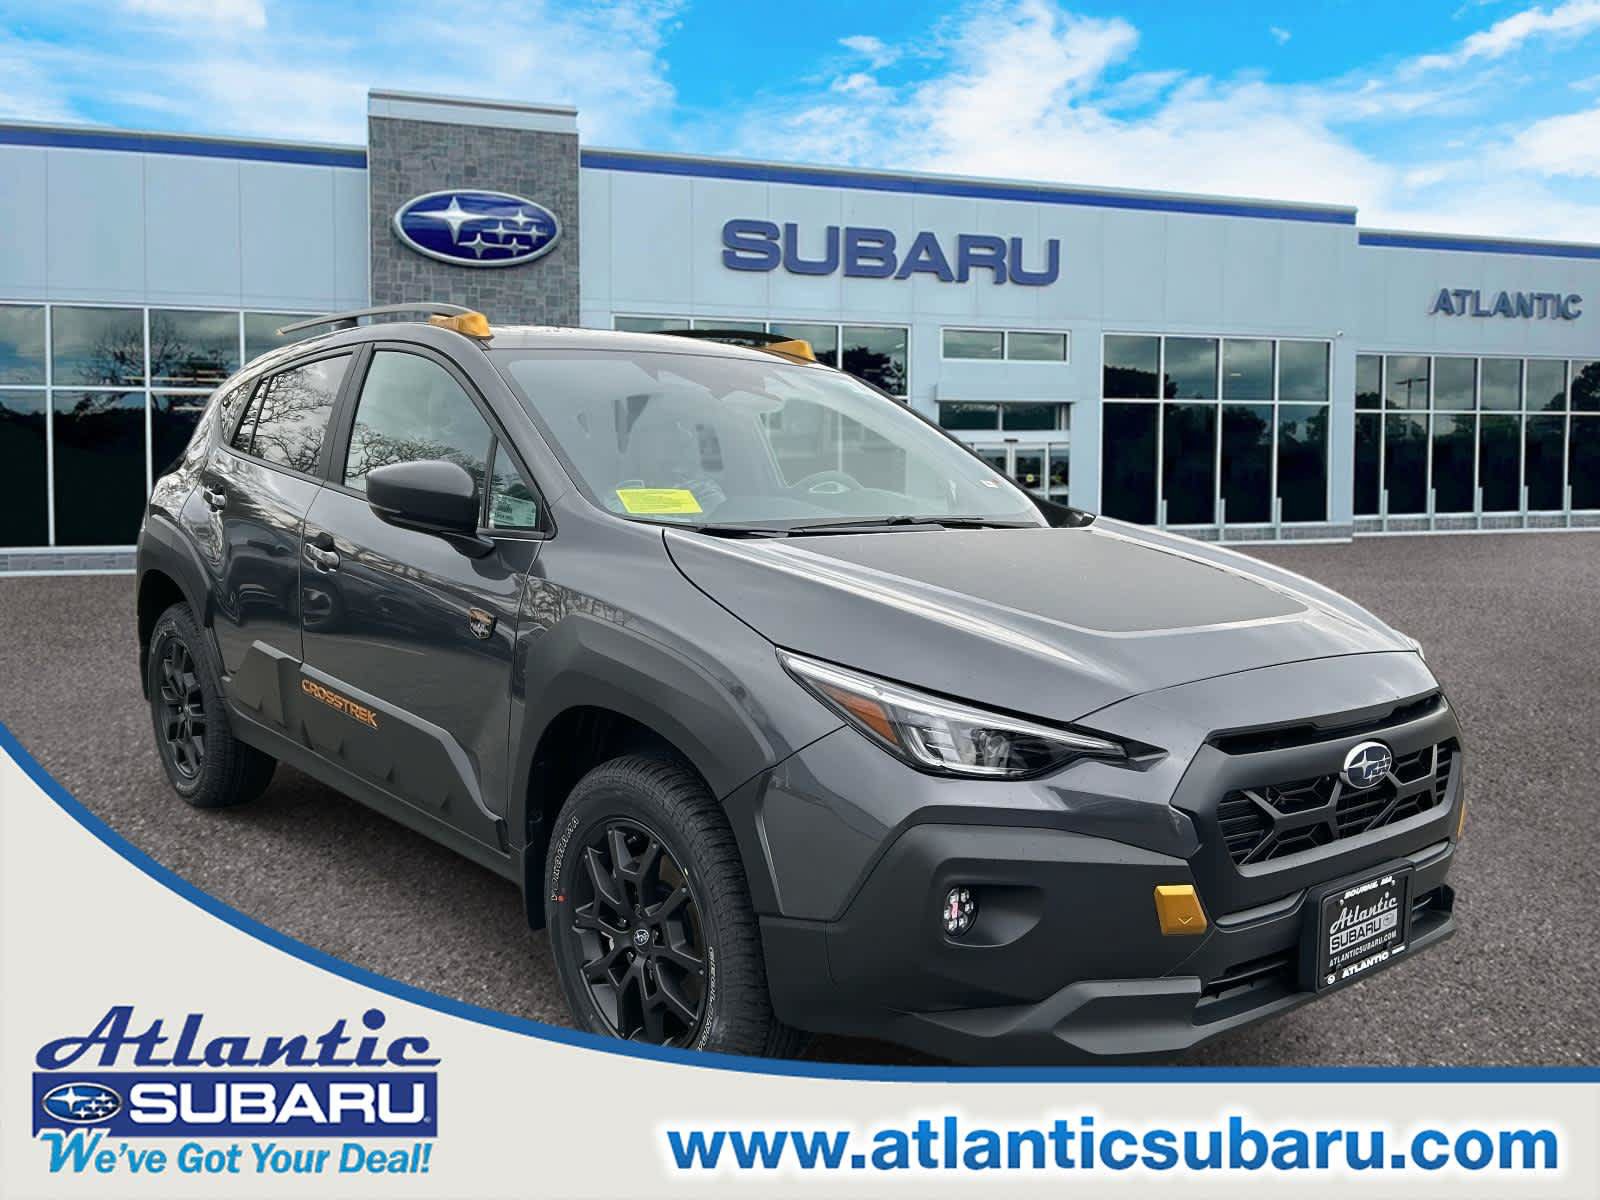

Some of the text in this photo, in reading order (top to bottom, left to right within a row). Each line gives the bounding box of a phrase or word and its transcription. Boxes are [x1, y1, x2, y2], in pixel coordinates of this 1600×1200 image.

[721, 218, 1061, 286] SUBARU
[1429, 287, 1583, 321] ATLANTIC
[301, 679, 379, 730] CROSSTREK
[1330, 891, 1398, 934] Atlantic
[1329, 930, 1397, 967] ATLANTICSUBARU.COM
[1331, 916, 1382, 950] SUBARU
[1341, 950, 1390, 979] ATLANTIC
